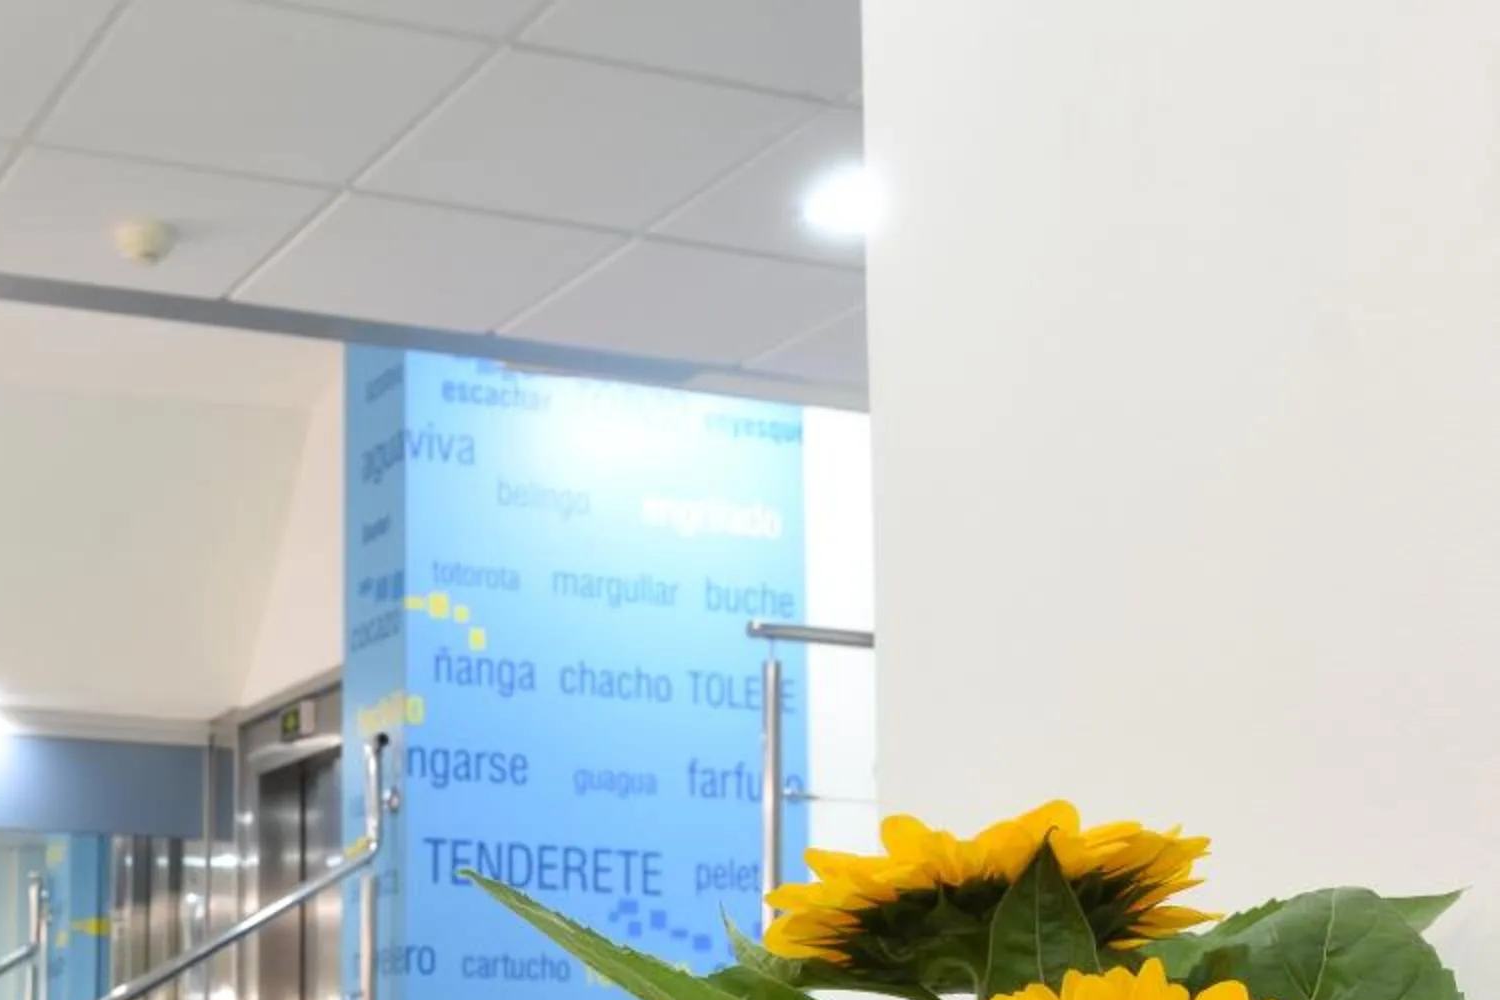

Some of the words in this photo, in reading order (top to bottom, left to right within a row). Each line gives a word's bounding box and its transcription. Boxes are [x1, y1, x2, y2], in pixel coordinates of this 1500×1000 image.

[432, 560, 520, 592] totorota
[552, 567, 678, 607] margullar
[705, 577, 795, 619] buche
[434, 648, 535, 697] ñanga
[560, 660, 672, 703] chacho
[688, 669, 796, 714] TOLEE
[573, 767, 657, 796] guagua
[423, 838, 663, 897] TENDERETE
[695, 858, 763, 897] pelet
[461, 950, 570, 984] cartucho
